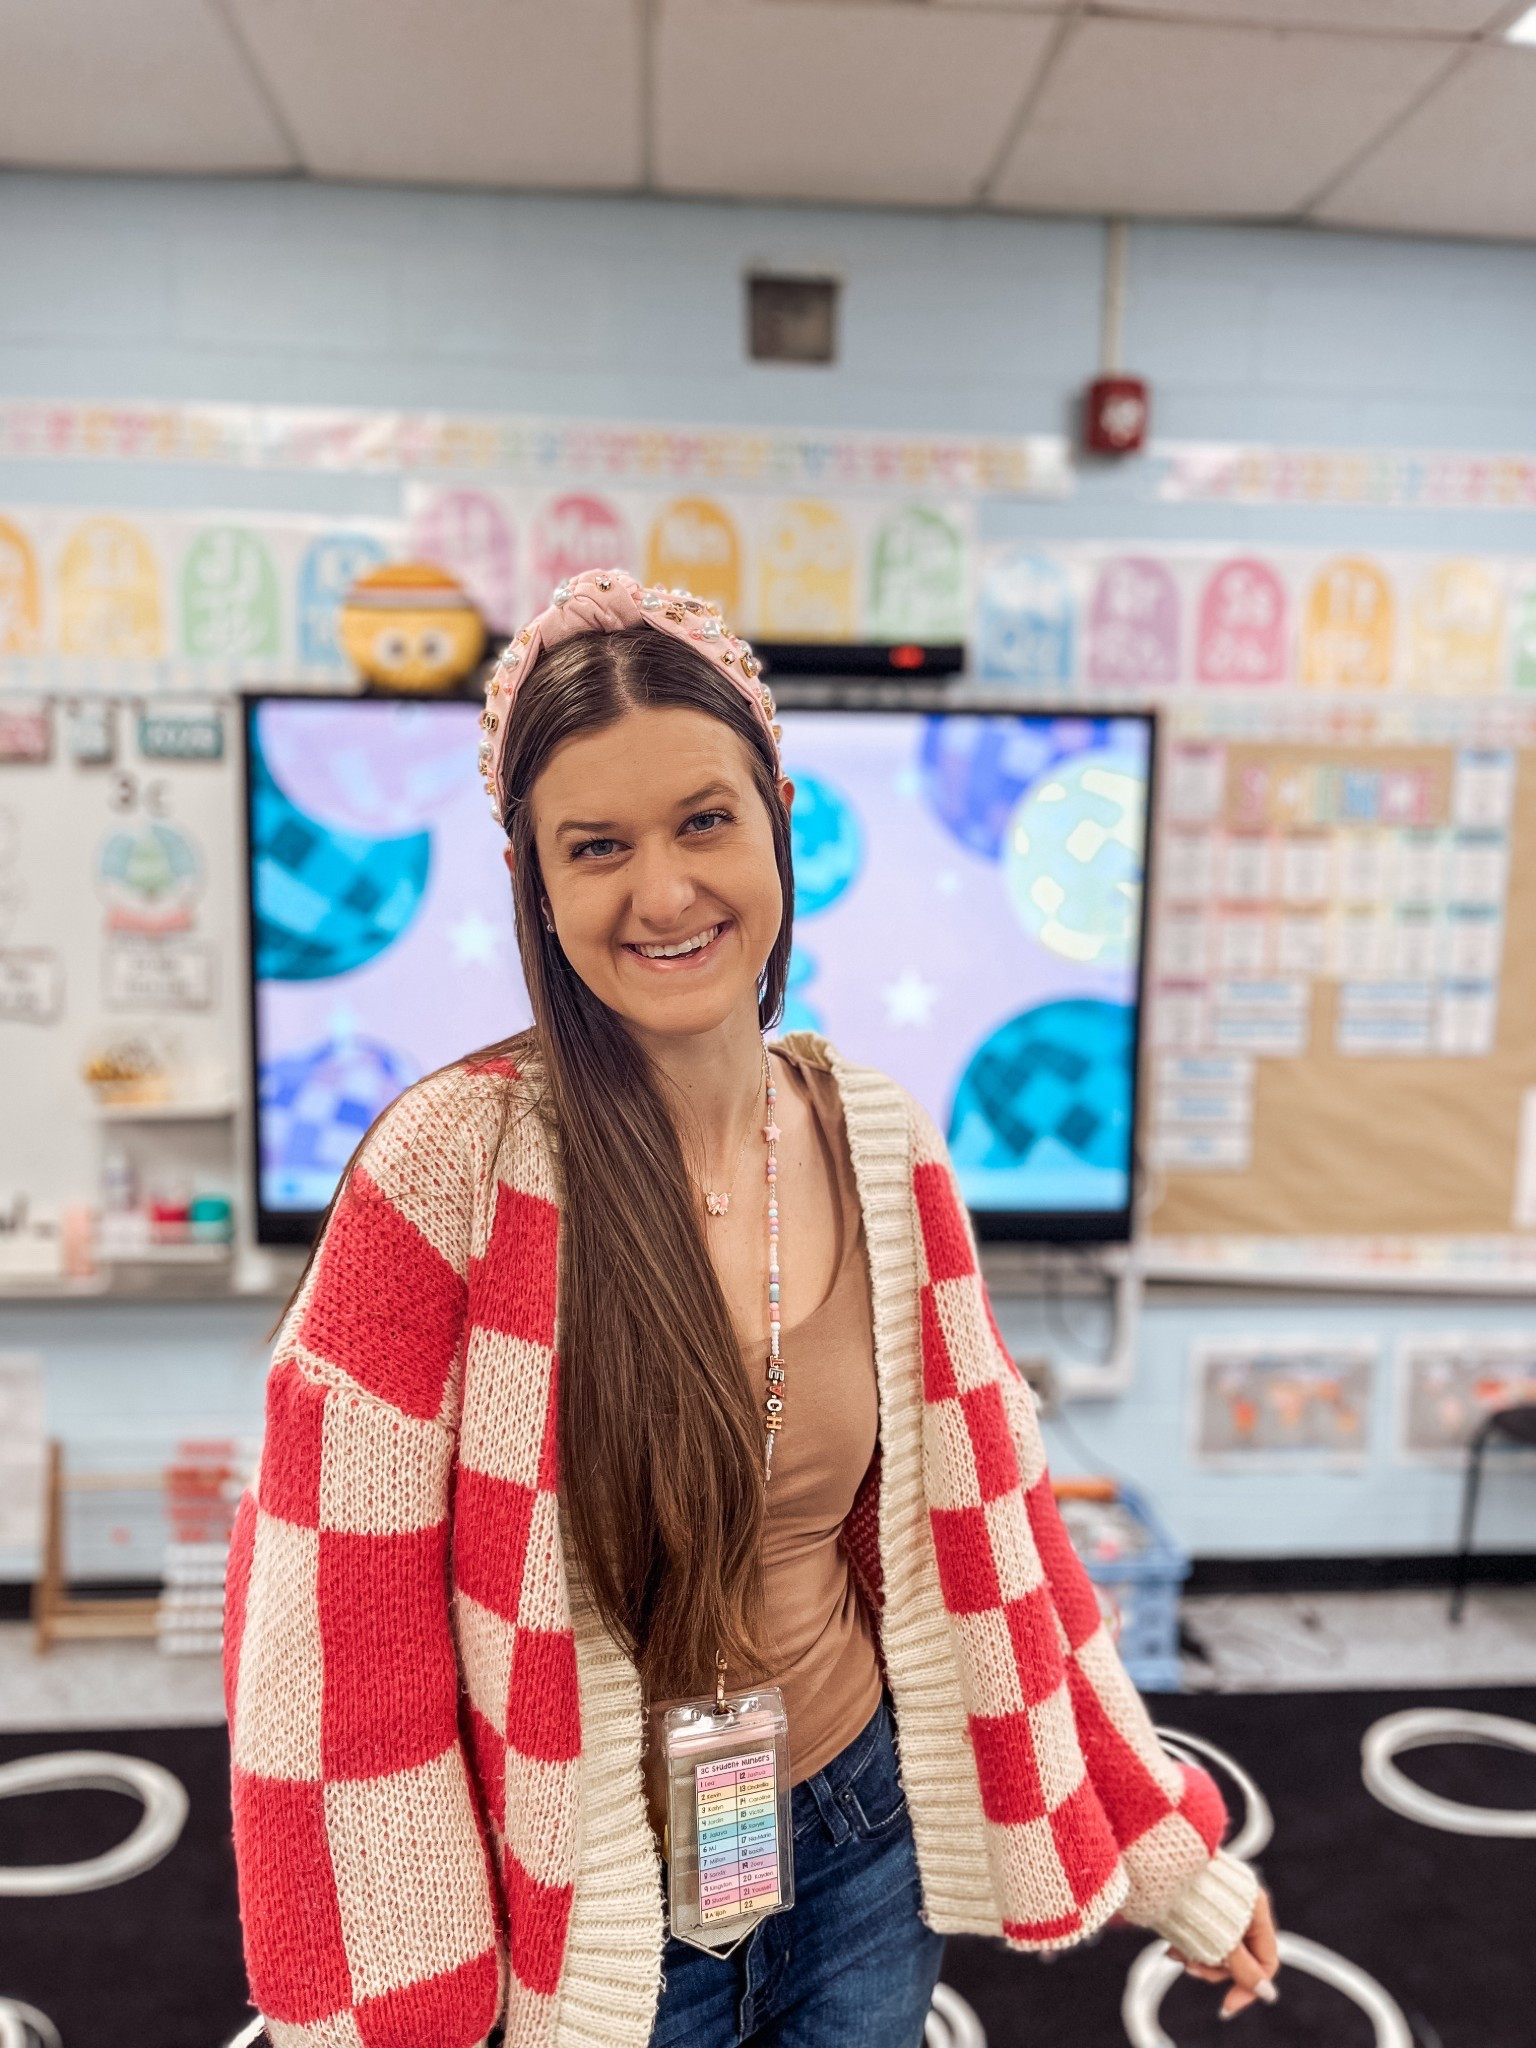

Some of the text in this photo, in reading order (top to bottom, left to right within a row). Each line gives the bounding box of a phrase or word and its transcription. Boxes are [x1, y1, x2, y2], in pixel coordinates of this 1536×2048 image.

[712, 1763, 739, 1772] Student
[742, 1755, 769, 1766] Numbers
[749, 1808, 764, 1816] Victor
